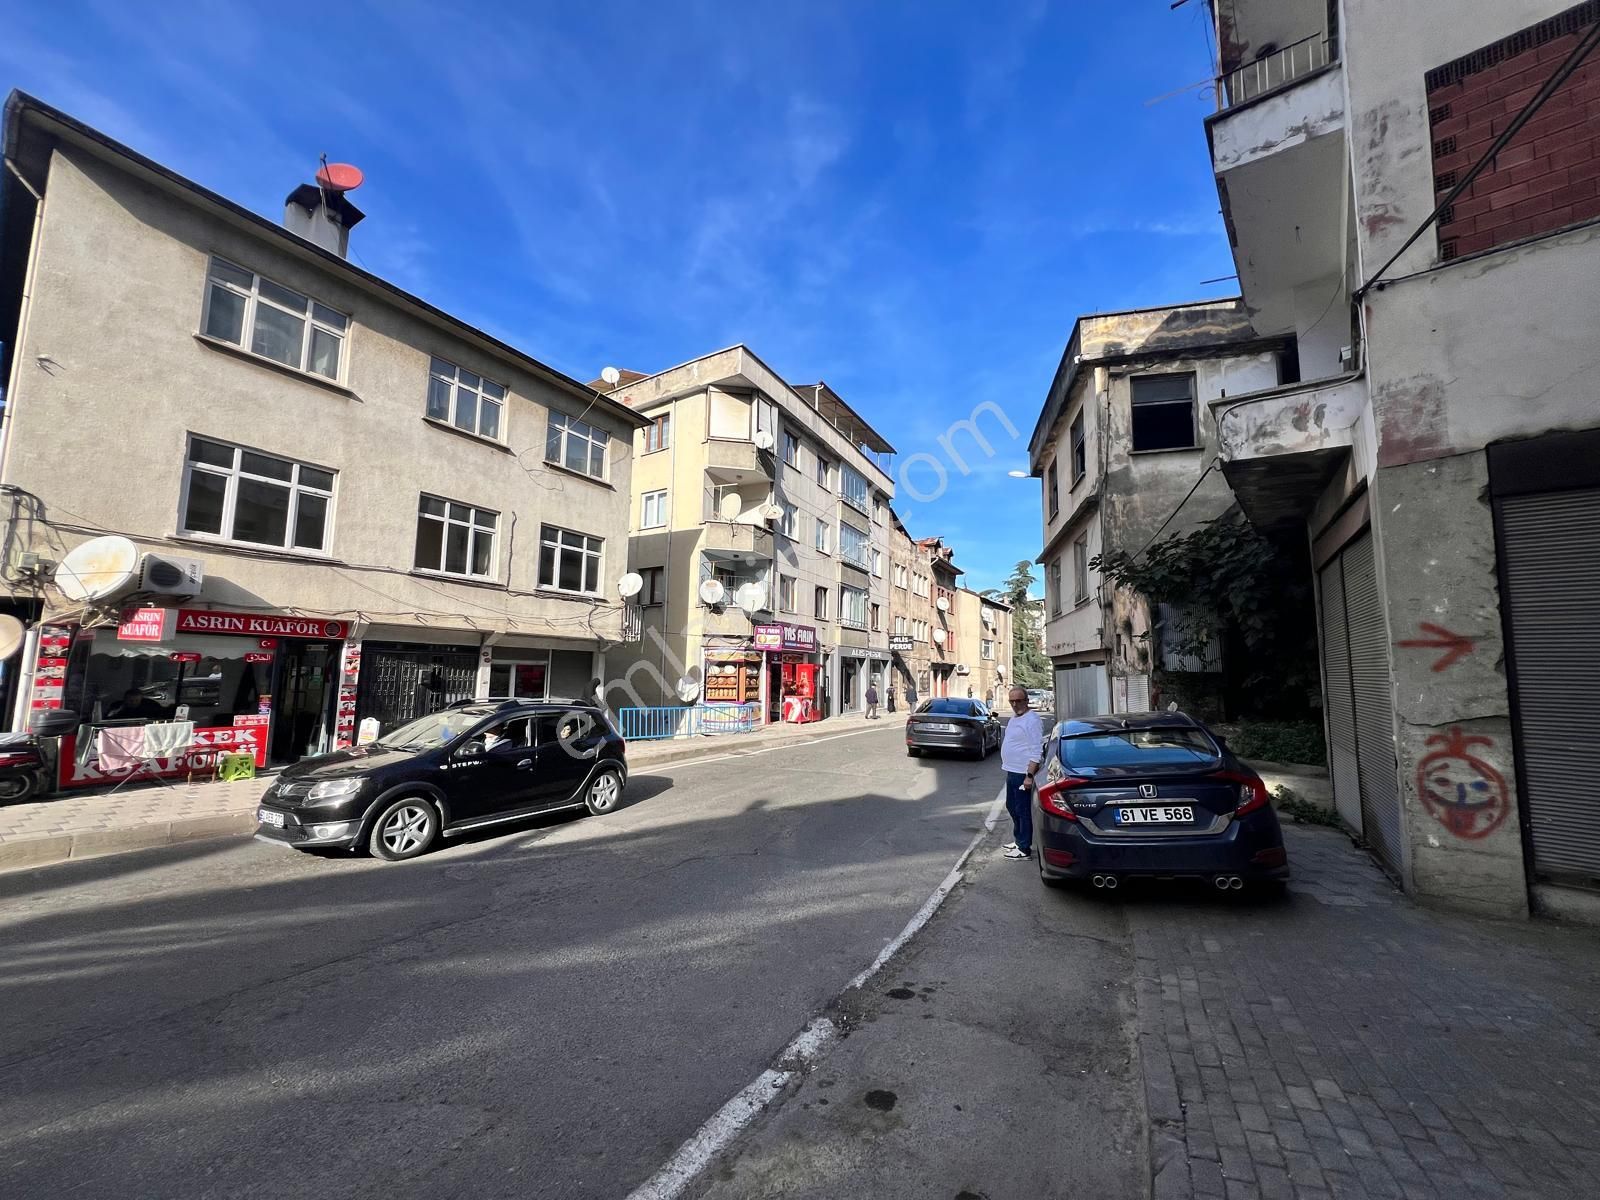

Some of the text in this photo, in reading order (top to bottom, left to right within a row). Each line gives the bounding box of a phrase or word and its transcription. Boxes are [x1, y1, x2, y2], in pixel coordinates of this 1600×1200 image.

[121, 621, 160, 637] KUAFÖR
[182, 615, 244, 630] ASRIN
[249, 618, 320, 635] KUAFÖR
[191, 729, 258, 746] KEK
[452, 760, 487, 769] STEPW
[1121, 807, 1192, 821] 61 VE 566
